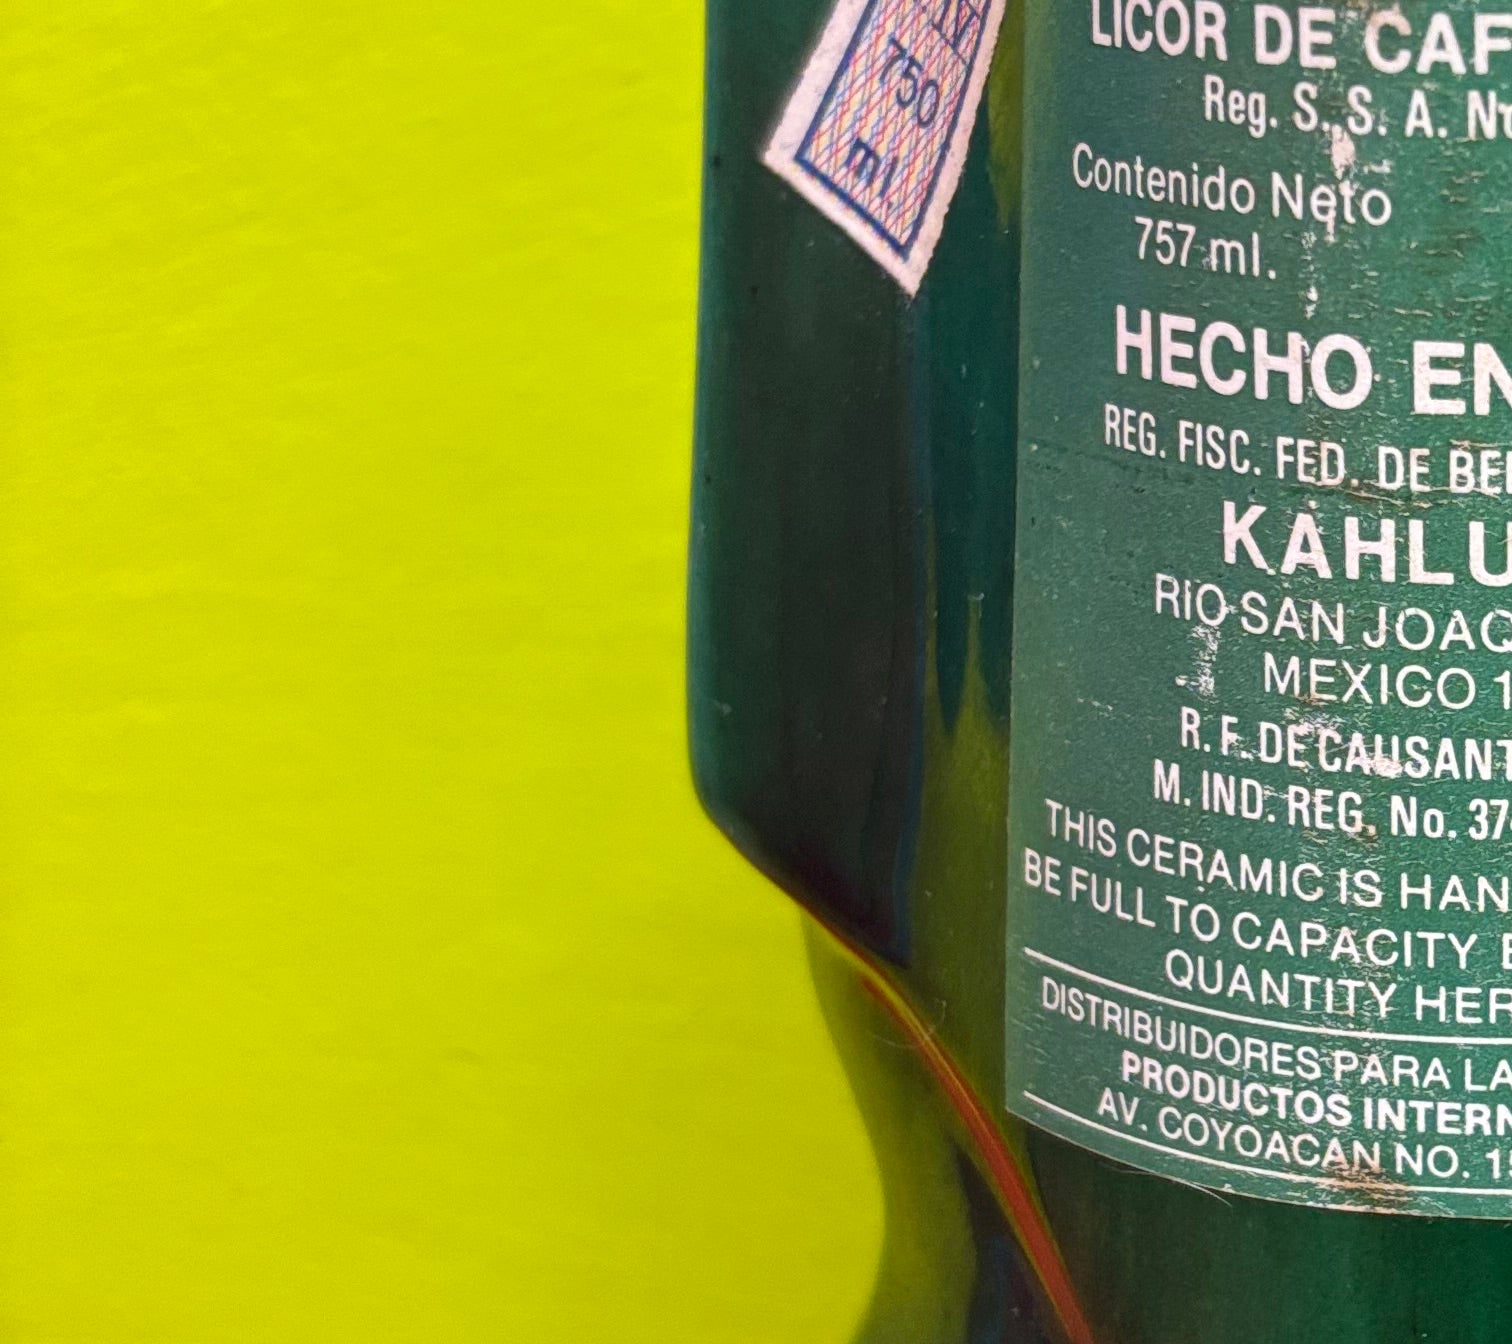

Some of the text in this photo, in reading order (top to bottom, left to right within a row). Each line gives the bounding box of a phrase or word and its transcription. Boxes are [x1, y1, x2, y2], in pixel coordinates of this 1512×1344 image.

[1254, 4, 1336, 70] DE
[880, 37, 940, 128] 750
[1204, 74, 1277, 139] Reg.
[1293, 82, 1330, 132] S.
[1347, 85, 1387, 136] S.
[1405, 90, 1448, 138] A.
[1072, 143, 1392, 228] Contenido Neto
[1134, 216, 1276, 280] 757 ml.
[1116, 304, 1373, 410] HECHO
[1105, 403, 1166, 458] REG.
[1178, 420, 1261, 476] FISC.
[1277, 436, 1358, 487] FED.
[1378, 445, 1430, 492] DE
[1155, 573, 1228, 627] RIO
[1241, 591, 1345, 645] SAN
[1264, 652, 1476, 710] MEXICO
[1259, 721, 1307, 768] DE
[1154, 759, 1191, 807] M.
[1202, 770, 1276, 823] IND.
[1390, 795, 1457, 839] No.
[1045, 798, 1117, 857] THIS
[1127, 828, 1324, 902] CERAMIC
[1340, 867, 1382, 908] IS
[1025, 847, 1061, 896] BE
[1071, 866, 1156, 928] FULL
[1165, 895, 1220, 943] TO
[1233, 912, 1477, 970] CAPACITY
[1165, 949, 1397, 1018] QUANTITY
[1042, 976, 1322, 1080] DISTRIBUIDORES
[1332, 1050, 1450, 1090] PARA
[1122, 1049, 1352, 1127] PRODUCTOS
[1099, 1087, 1148, 1131] AV.
[1158, 1106, 1381, 1173] COYOACAN
[1395, 1143, 1471, 1179] NO.
